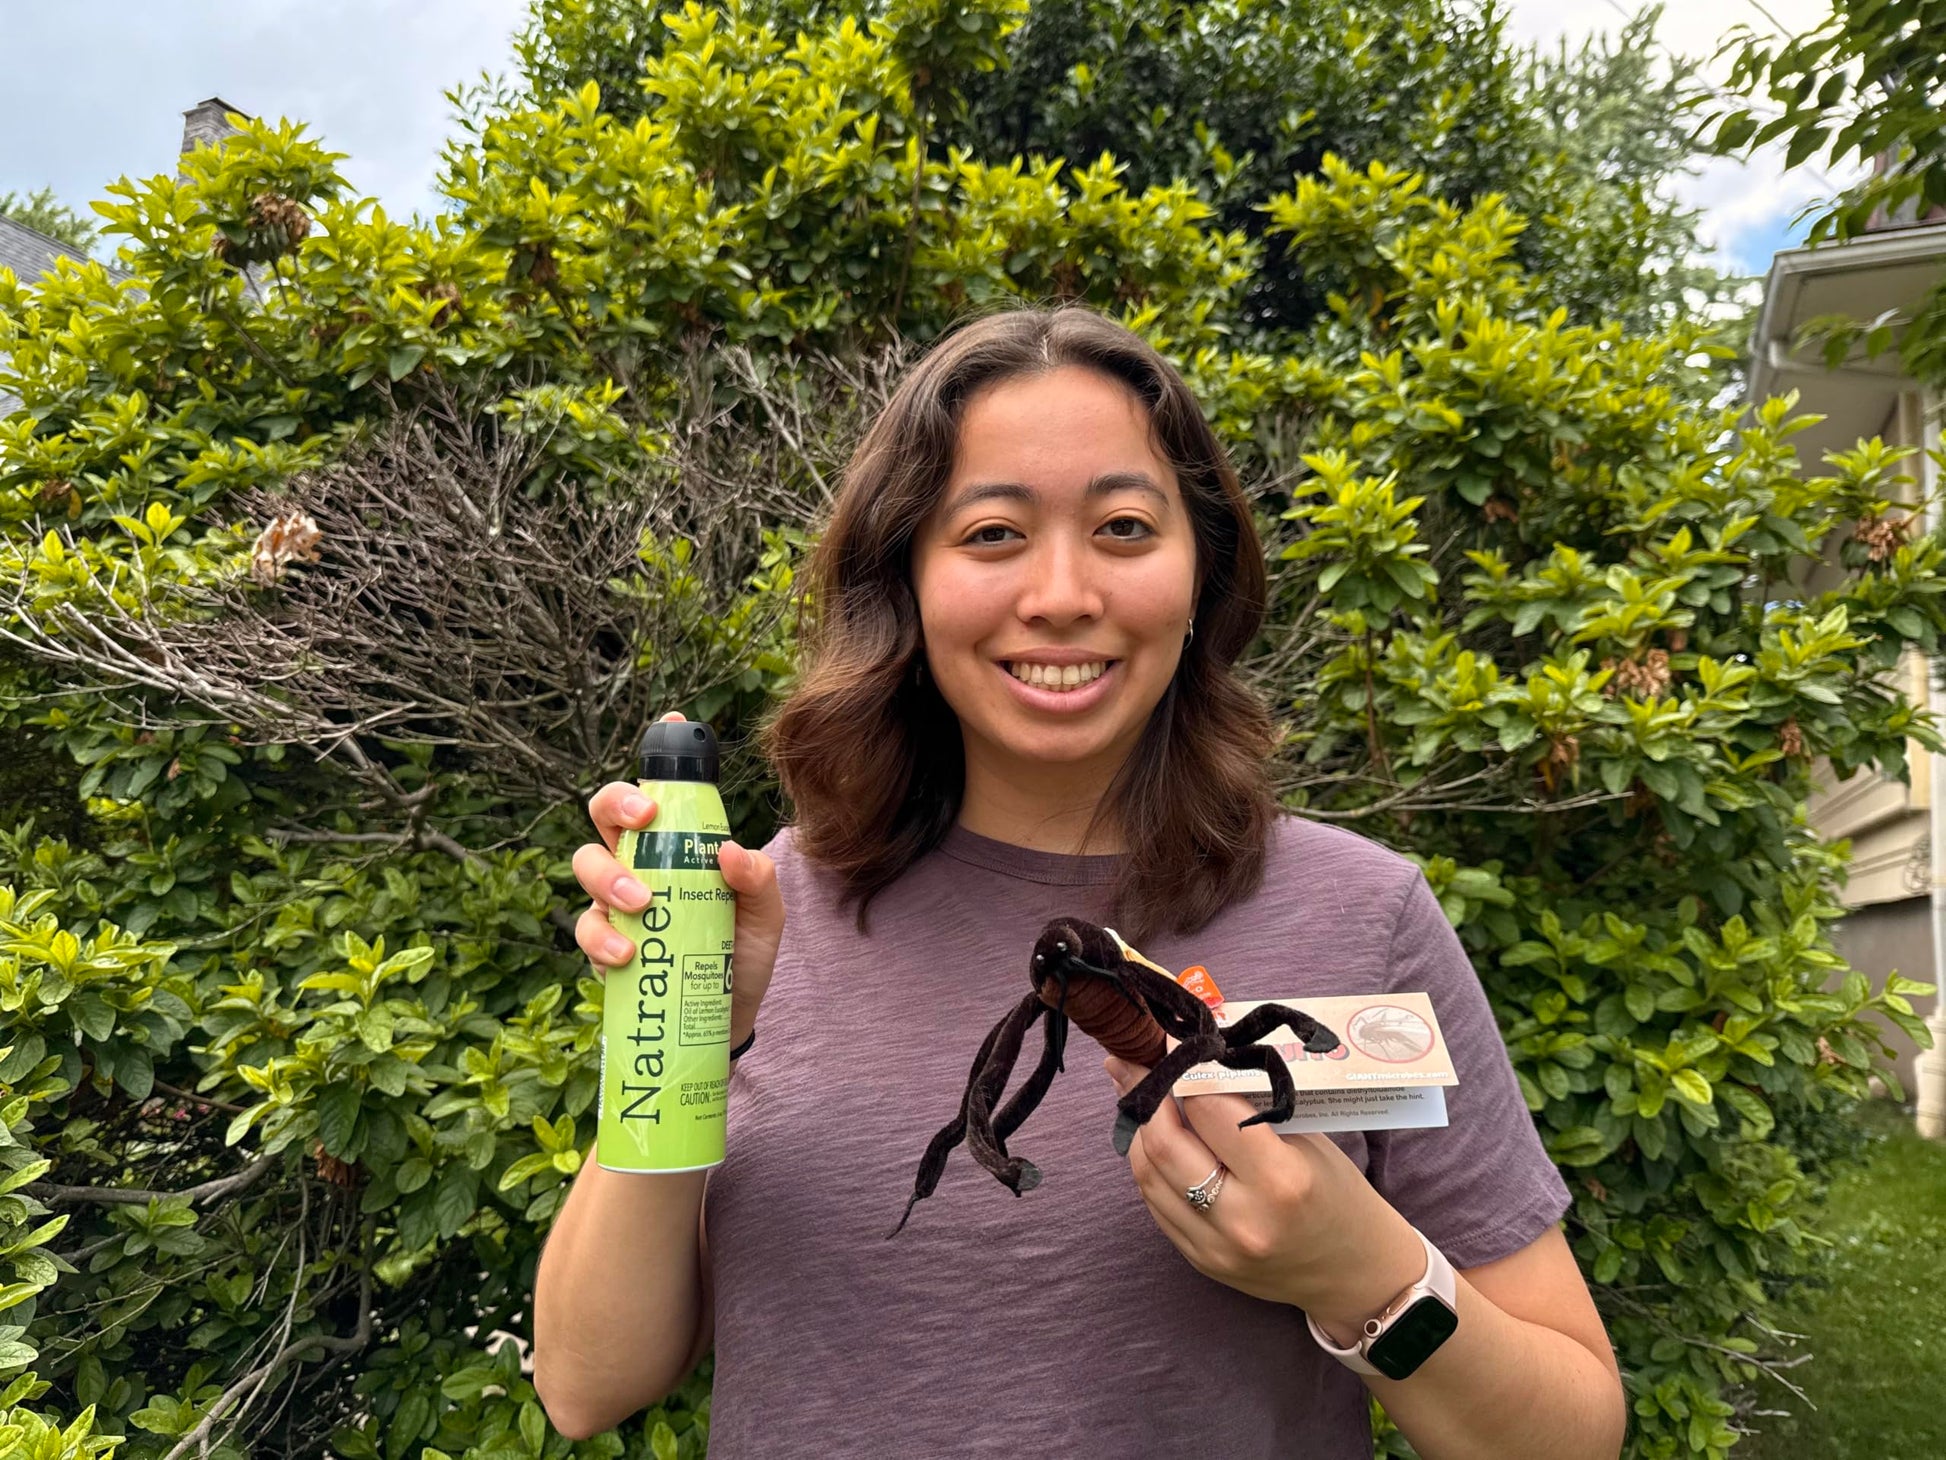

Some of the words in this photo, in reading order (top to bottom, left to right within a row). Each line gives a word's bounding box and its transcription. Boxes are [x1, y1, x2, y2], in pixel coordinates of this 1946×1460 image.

[684, 838, 719, 855] Plant
[683, 856, 714, 865] Active
[679, 887, 713, 901] Insect
[695, 961, 718, 972] Repels
[684, 971, 724, 982] Mosquitoes
[690, 981, 701, 990] for
[702, 982, 712, 991] up
[713, 981, 720, 989] to
[1182, 1071, 1215, 1081] Culex
[1328, 1096, 1341, 1104] She
[1343, 1095, 1364, 1105] might
[1364, 1094, 1378, 1103] just
[1379, 1093, 1394, 1101] take
[1396, 1092, 1408, 1100] the
[1409, 1091, 1424, 1100] hint.
[1340, 1109, 1359, 1118] Rights
